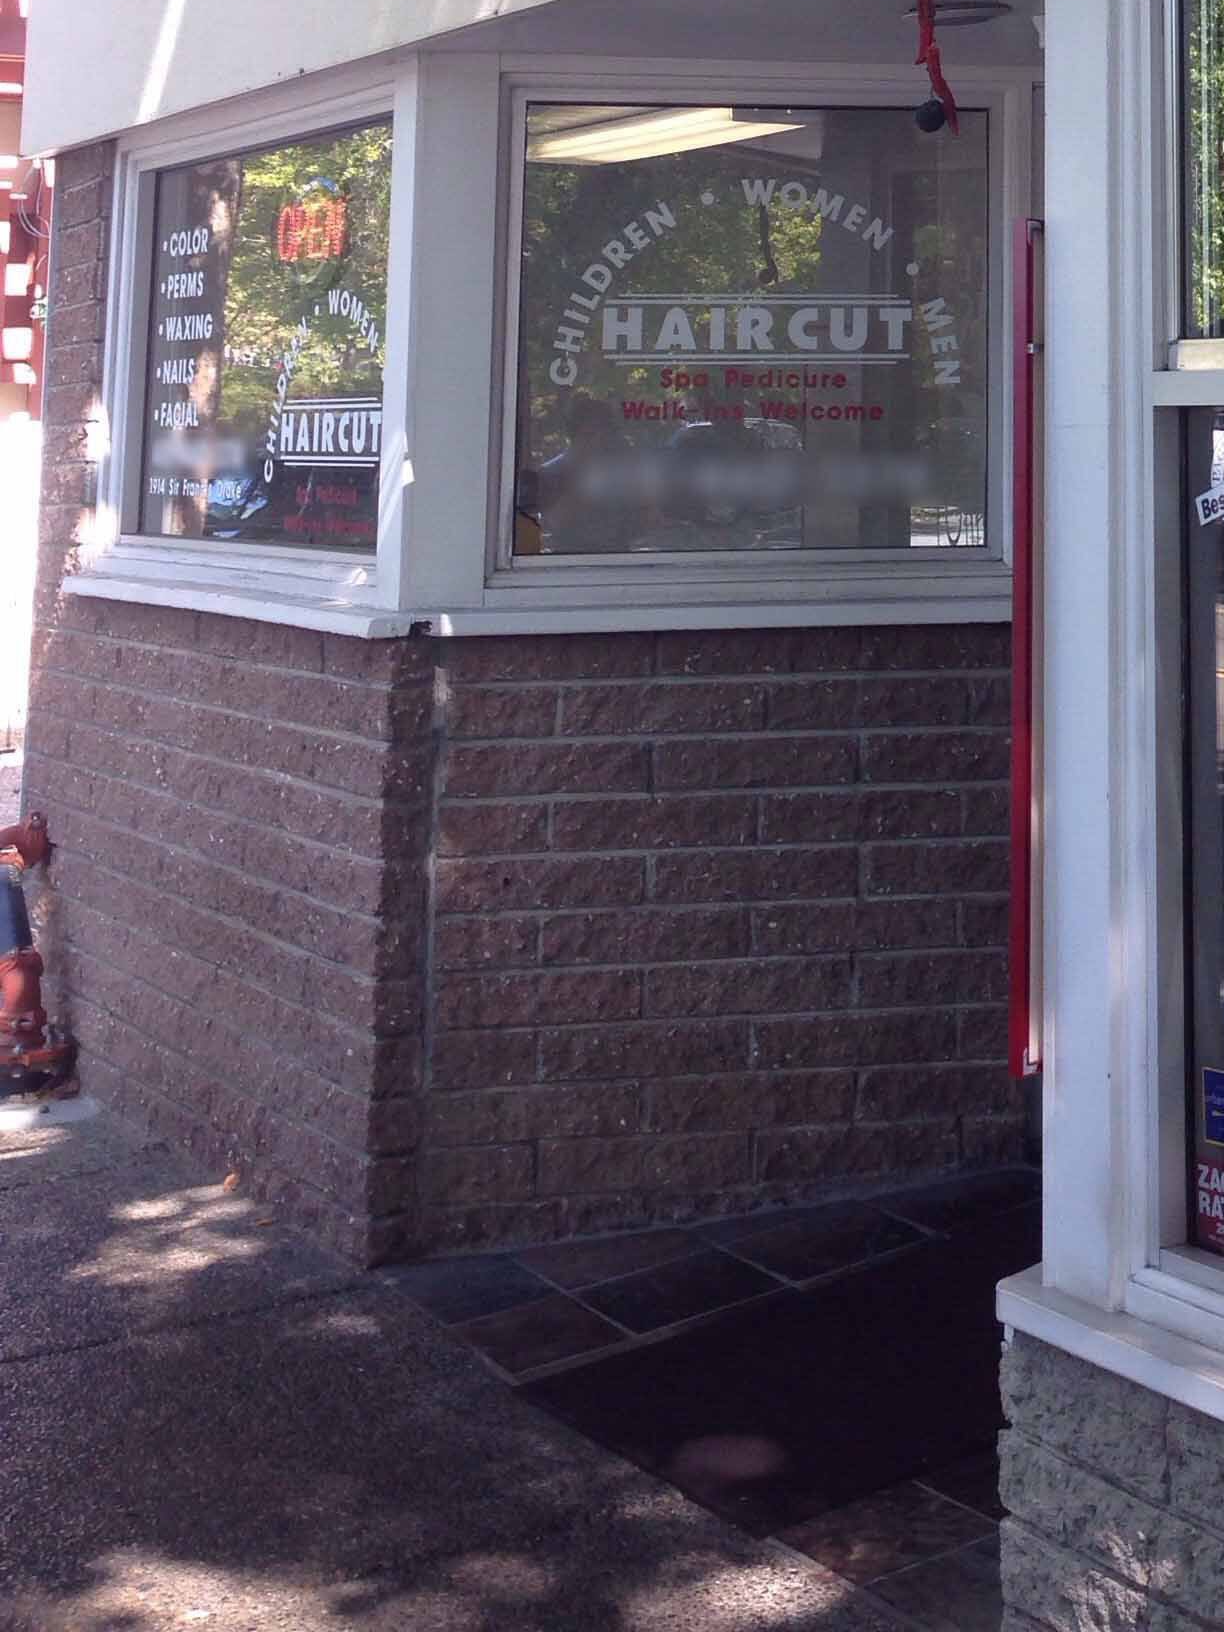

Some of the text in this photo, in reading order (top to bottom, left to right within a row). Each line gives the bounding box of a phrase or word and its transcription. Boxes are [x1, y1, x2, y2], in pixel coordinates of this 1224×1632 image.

[742, 179, 895, 251] WOMEN
[169, 228, 208, 256] COLOR
[167, 271, 204, 299] PERMS
[550, 201, 676, 386] CHILDREN
[165, 313, 213, 341] WAXING
[329, 289, 379, 353] WOMEN
[602, 306, 912, 353] HAIRCUT
[919, 297, 961, 386] MEN
[162, 358, 195, 384] NAILS
[660, 368, 847, 390] Spa Pedicure
[760, 401, 884, 421] Welcome
[280, 411, 382, 454] HAIRCUT
